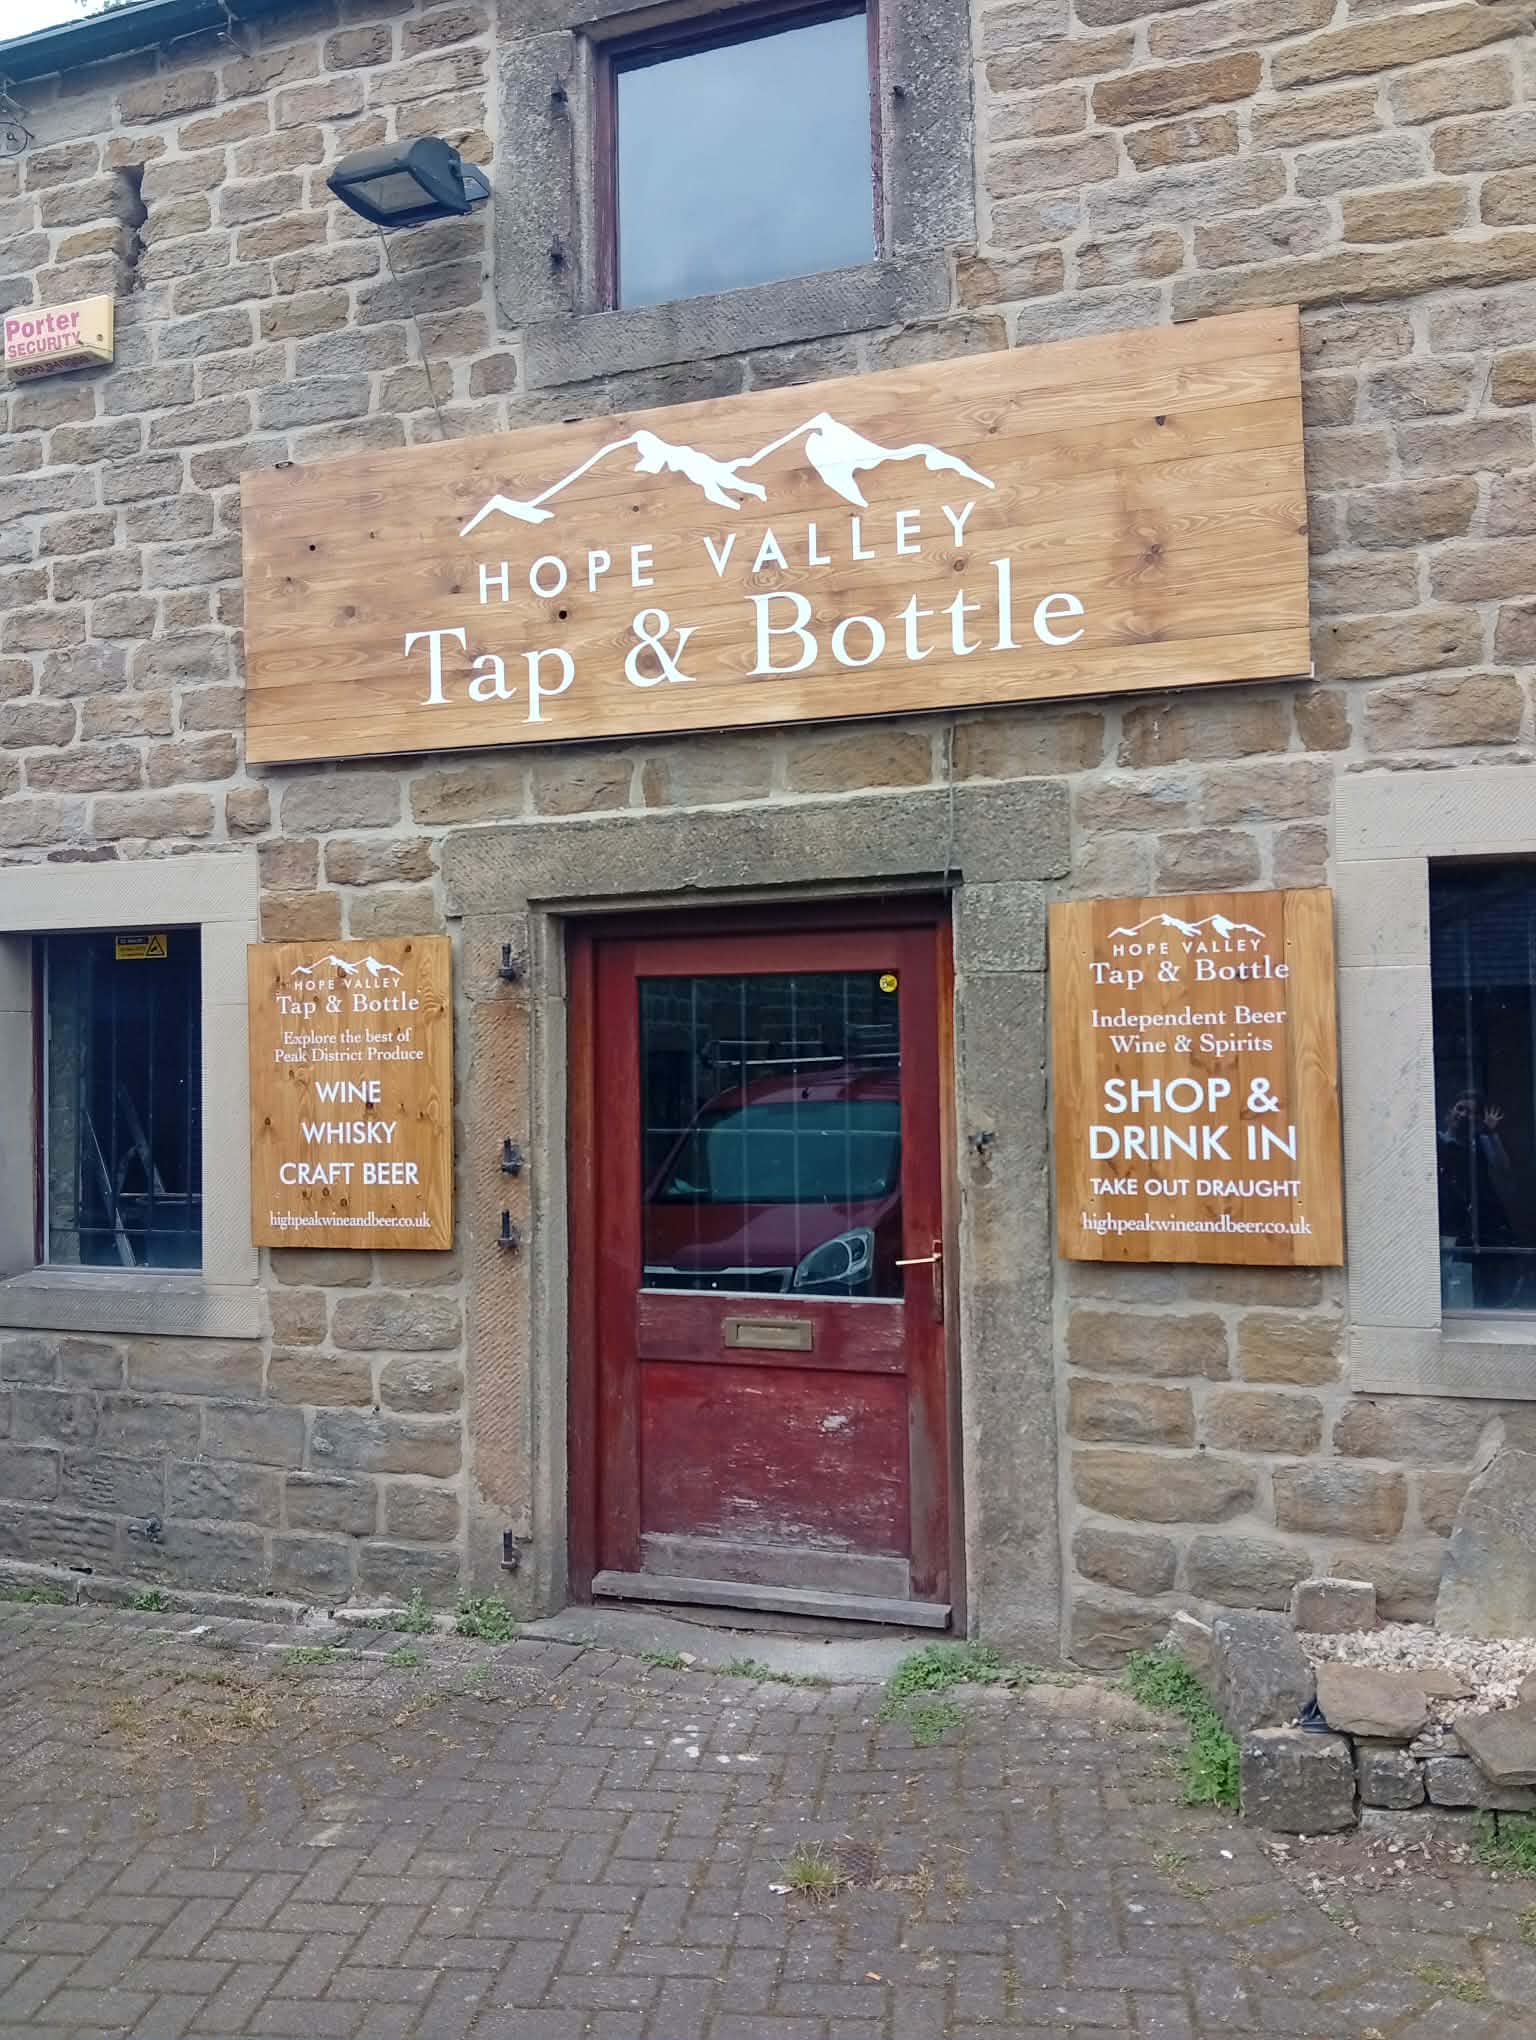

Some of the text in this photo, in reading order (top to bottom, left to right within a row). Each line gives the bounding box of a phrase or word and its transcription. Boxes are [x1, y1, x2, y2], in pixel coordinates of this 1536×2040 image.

[5, 312, 79, 341] Porter
[8, 331, 80, 358] SECURITY
[479, 501, 975, 604] HOPE VALLEY
[404, 558, 1085, 722] Tap & Bottle
[1113, 939, 1261, 957] HOPE VALLEY
[294, 977, 400, 991] HOPE VALLEY
[1089, 955, 1289, 990] Tap & Bottle
[276, 992, 419, 1019] Tap & Bottle
[1091, 1005, 1287, 1032] Independent Beer
[284, 1027, 412, 1049] Explore the best of
[1110, 1032, 1273, 1057] Wine & Spirits
[274, 1047, 424, 1063] Peak District Produce
[315, 1080, 381, 1104] WINE
[1103, 1077, 1280, 1114] SHOP &
[302, 1121, 397, 1145] WHISKY
[1089, 1125, 1297, 1160] DRINK IN
[279, 1162, 420, 1185] CRAFT BEER
[1089, 1178, 1301, 1198] TAKE OUT DRAUGHT
[269, 1211, 431, 1230] highpeakwineandbeer.co.uk
[1081, 1212, 1312, 1235] highpeakwineandbeer.co.uk
